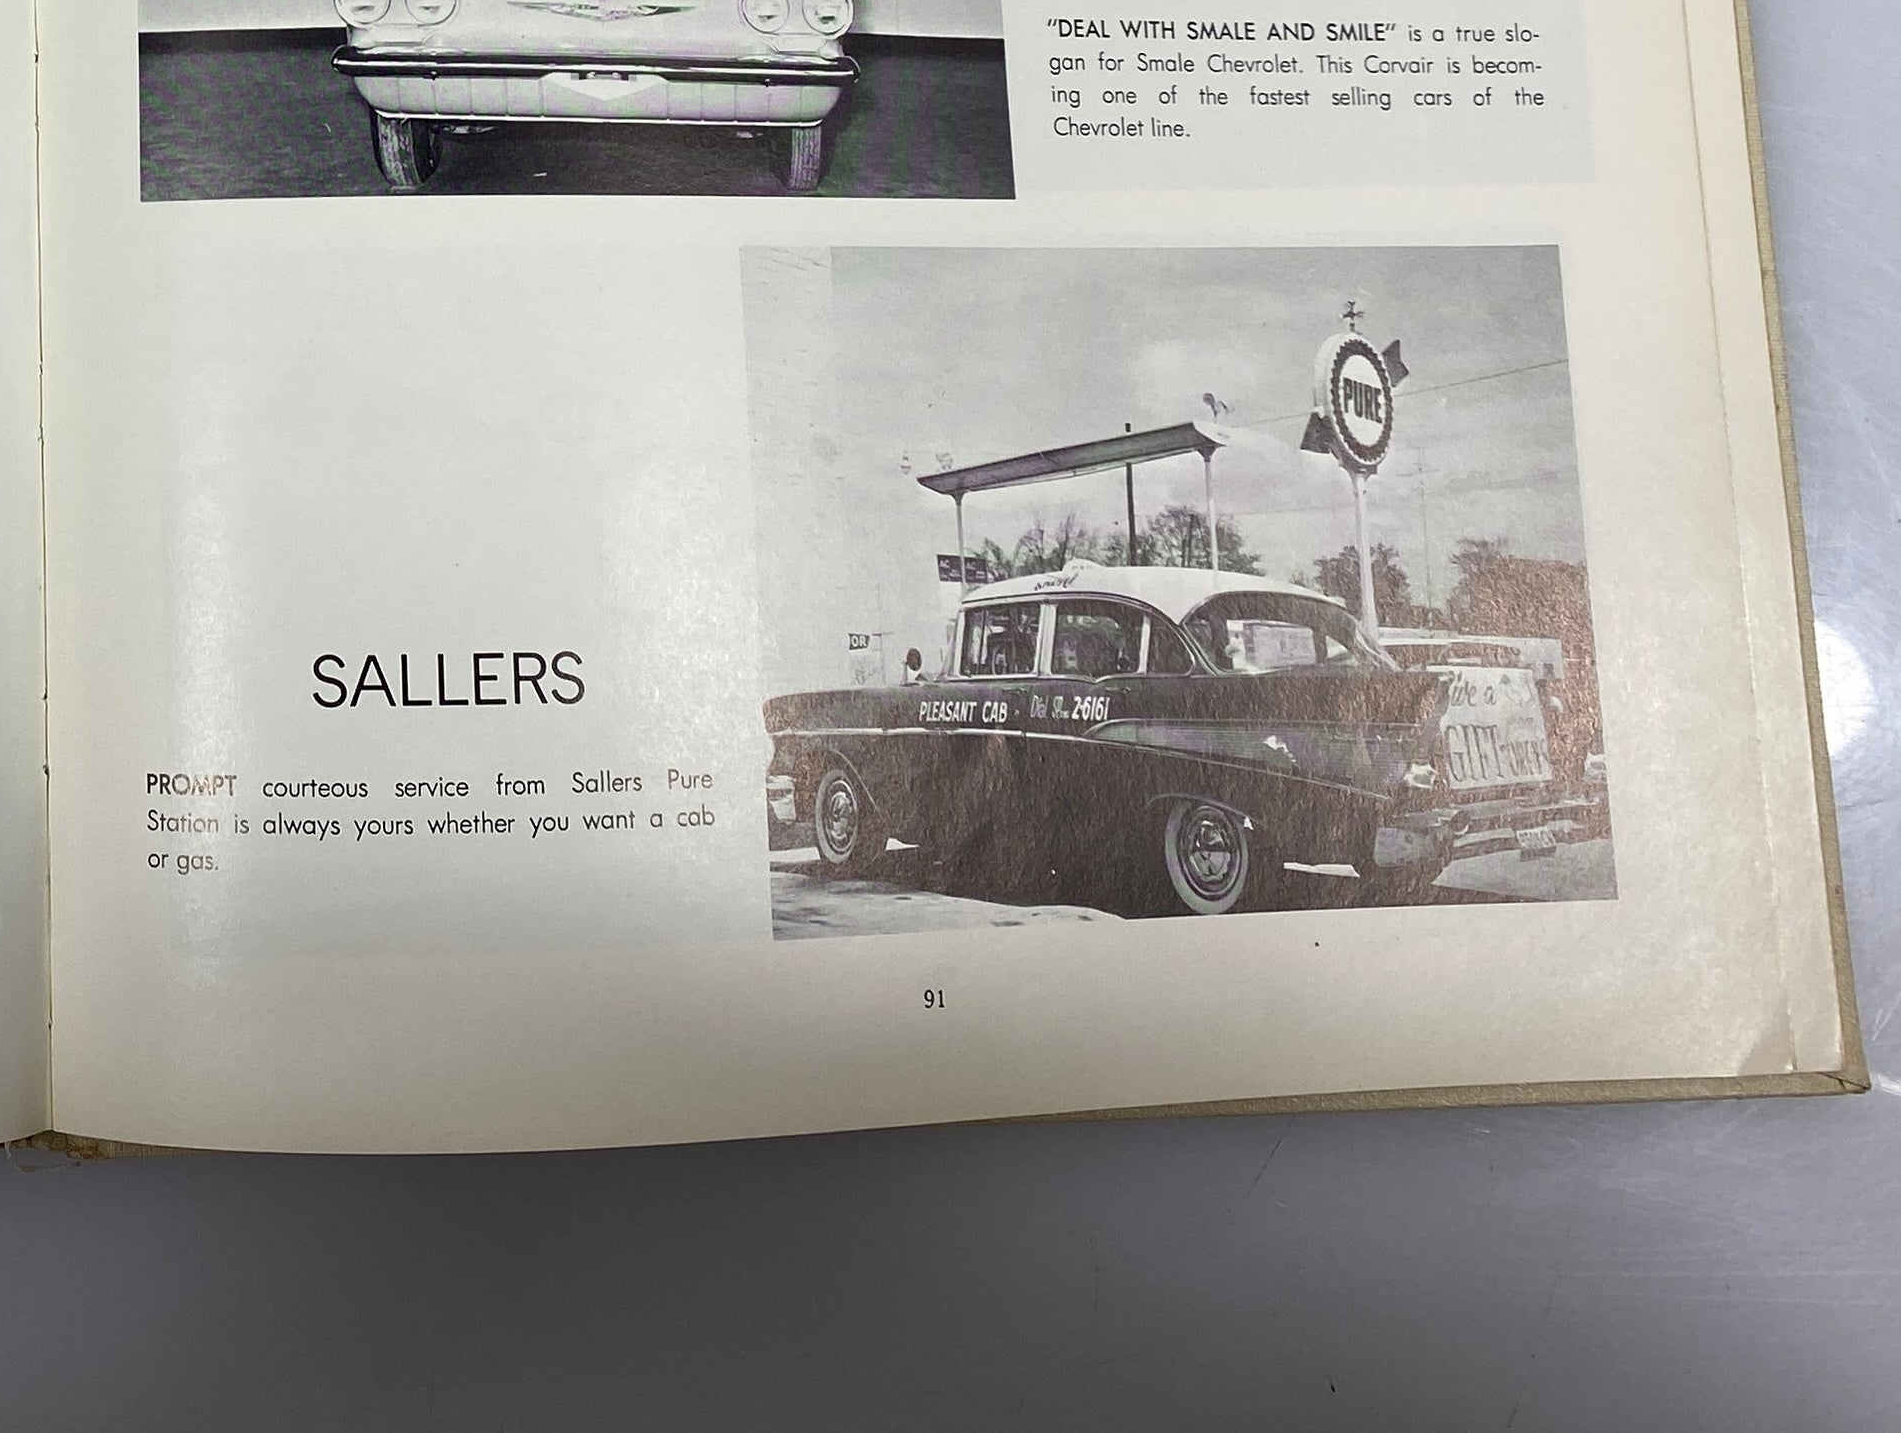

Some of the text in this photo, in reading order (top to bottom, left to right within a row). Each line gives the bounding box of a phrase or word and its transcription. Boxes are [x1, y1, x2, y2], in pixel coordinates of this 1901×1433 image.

[1119, 19, 1176, 40] WITH
[1186, 21, 1256, 41] SMALE
[1266, 22, 1315, 42] AND
[1407, 24, 1423, 43] is
[1431, 28, 1445, 43] a
[1455, 26, 1496, 43] true
[1505, 22, 1540, 43] slo-
[1048, 50, 1543, 76] gan for Smale Chevrolet. This Corvair is becom-
[1051, 84, 1545, 112] ing one of the fastest selling cars of the
[1053, 115, 1191, 138] Chevrolet line.
[1343, 376, 1383, 424] PURE
[312, 650, 585, 709] SALLERS
[918, 701, 977, 724] PLEASANT
[982, 701, 1008, 724] CAB
[1071, 695, 1110, 721] 2-6161
[146, 768, 714, 798] PROMPT courteous service from Sallers Pure
[146, 803, 716, 842] Station is always yours whether you want a cab
[147, 853, 219, 876] or gas.
[924, 989, 945, 1008] 91
